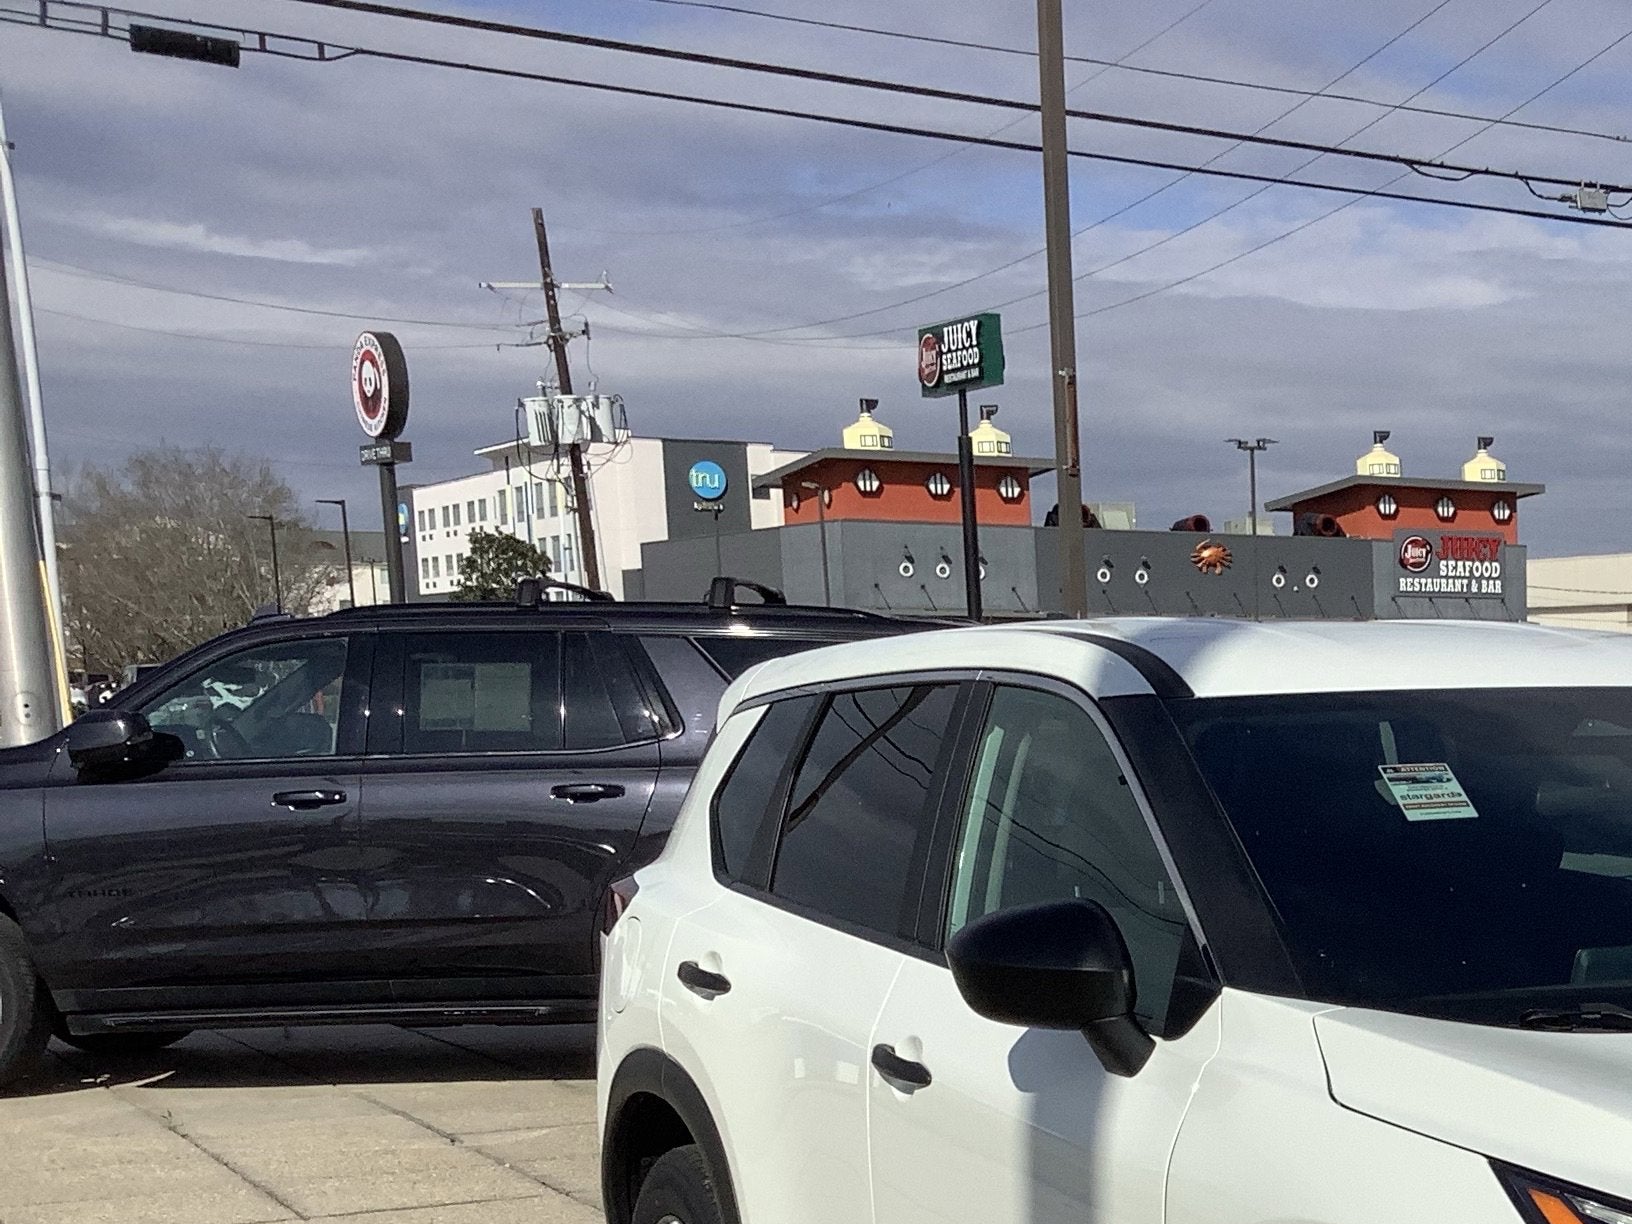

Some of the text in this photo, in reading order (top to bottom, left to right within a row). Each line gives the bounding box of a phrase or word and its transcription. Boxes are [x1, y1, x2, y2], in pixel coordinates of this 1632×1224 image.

[941, 320, 978, 352] JUICY
[942, 347, 979, 371] SEAFOOD
[690, 466, 719, 489] tru
[1435, 536, 1501, 561] JUICY
[1439, 560, 1500, 578] SEAFOOD
[1399, 577, 1502, 594] RESTAURANT & BAR
[1401, 765, 1445, 773] ATTENTION
